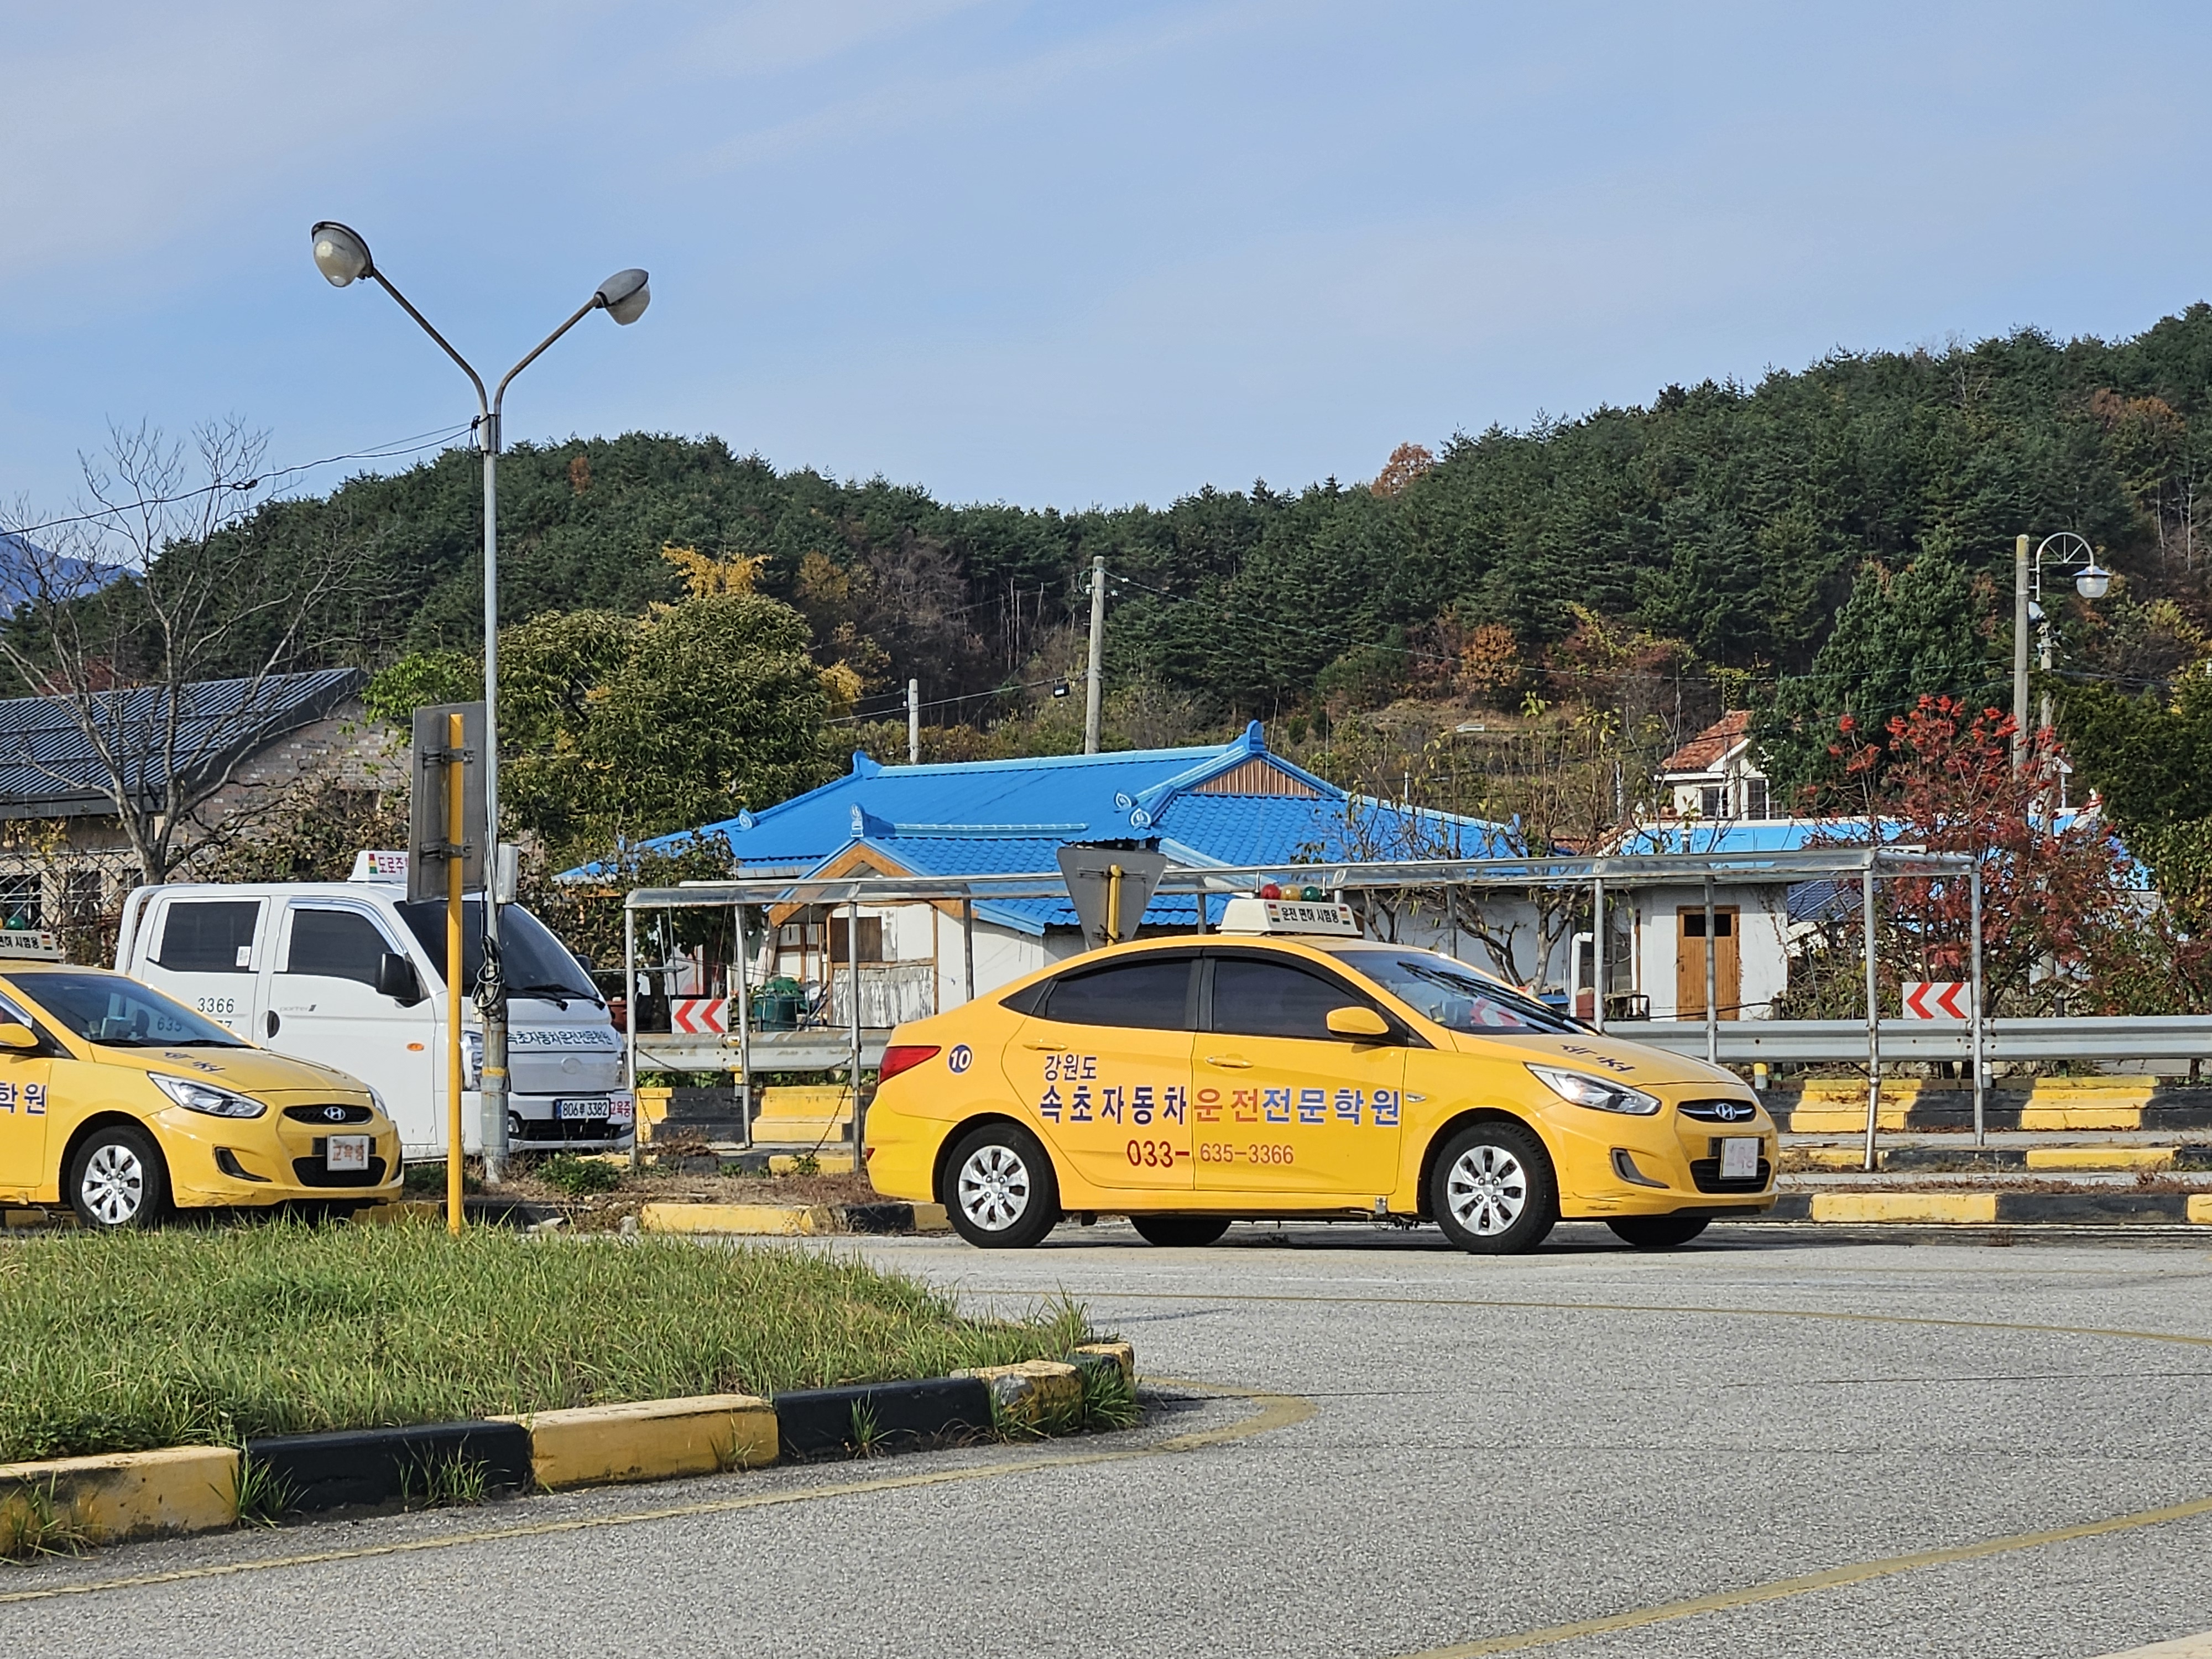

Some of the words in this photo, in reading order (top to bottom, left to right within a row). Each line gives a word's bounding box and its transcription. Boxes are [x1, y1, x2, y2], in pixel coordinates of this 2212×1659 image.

[1281, 907, 1298, 922] 운전
[1298, 907, 1316, 922] 면허
[1316, 908, 1339, 924] 시험용
[15, 936, 39, 949] 시험용
[197, 997, 234, 1013] 3366
[949, 1049, 972, 1070] 10
[1044, 1054, 1098, 1082] 강원도
[0, 1082, 46, 1114] 학원
[1199, 1143, 1294, 1165] 635-3366
